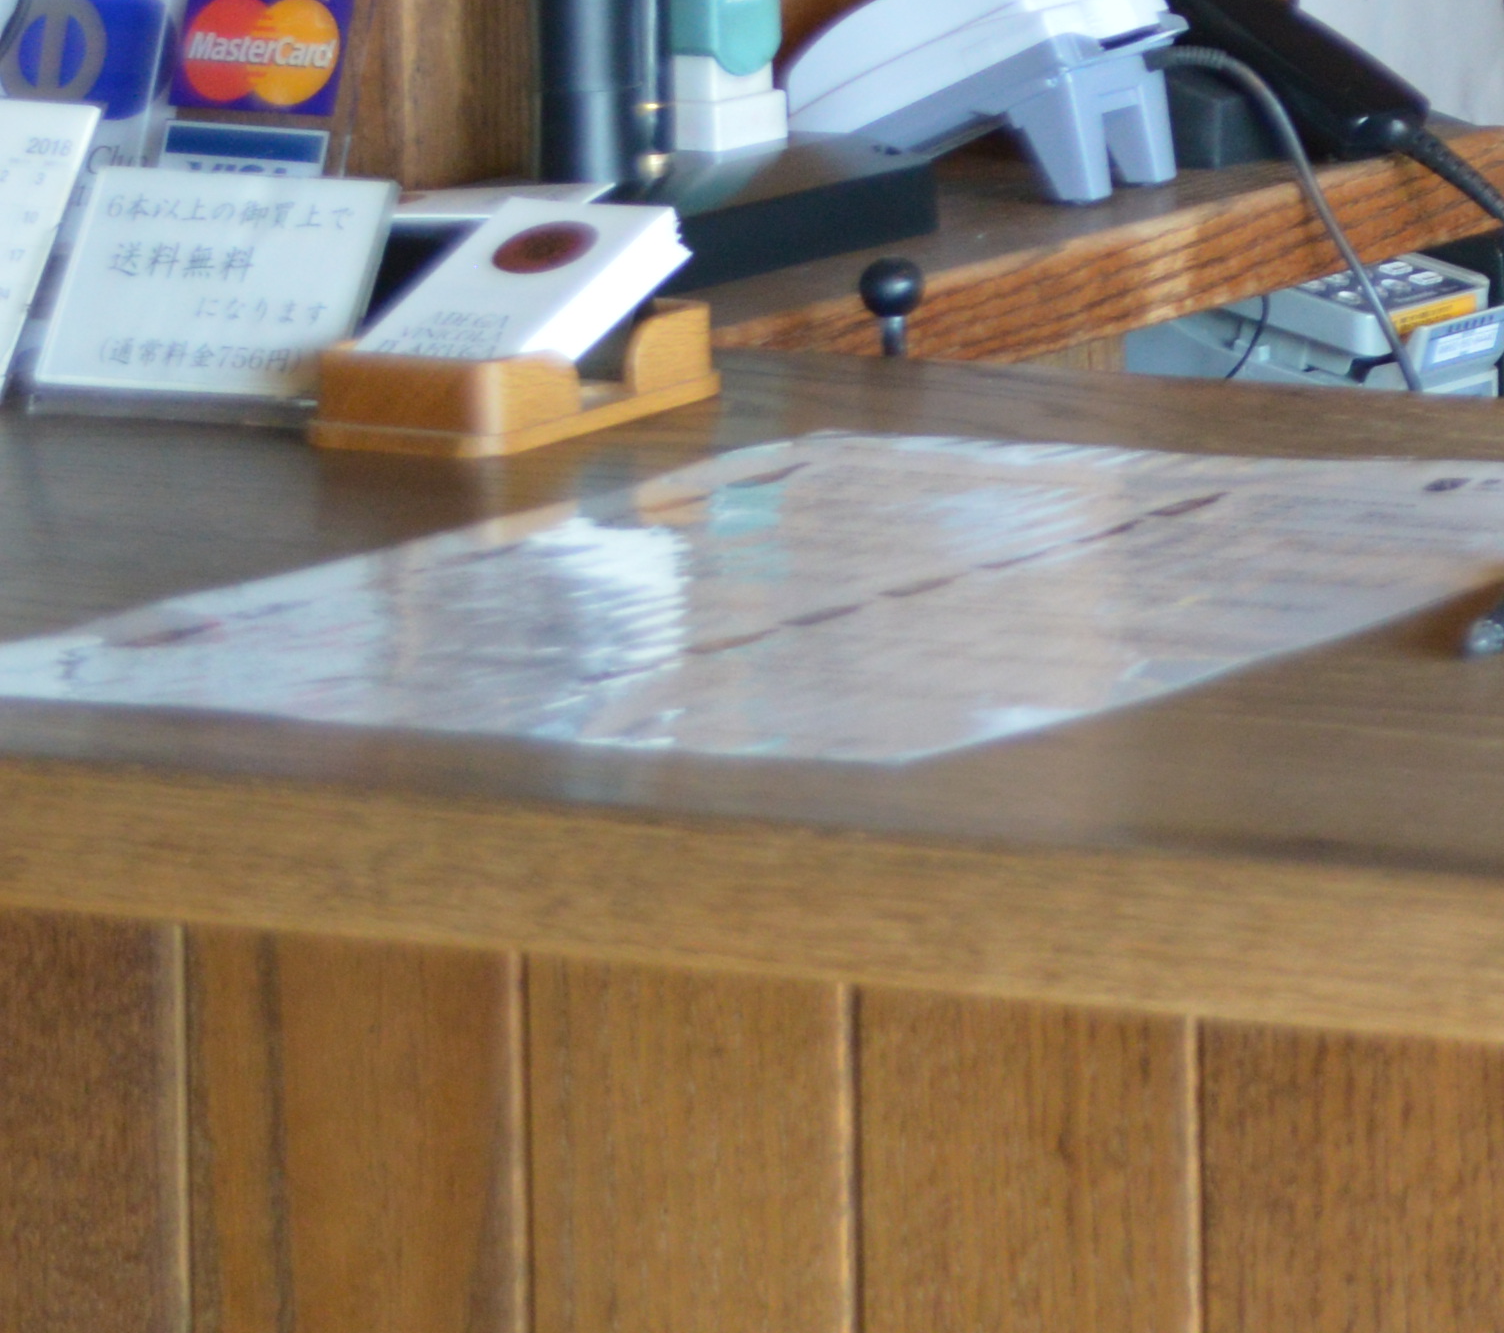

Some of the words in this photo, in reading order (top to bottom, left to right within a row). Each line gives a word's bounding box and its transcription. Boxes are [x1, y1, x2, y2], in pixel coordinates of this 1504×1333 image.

[188, 30, 338, 71] MasterCard
[25, 136, 73, 158] 2018
[108, 240, 256, 283] 送料無料
[194, 296, 329, 326] になります
